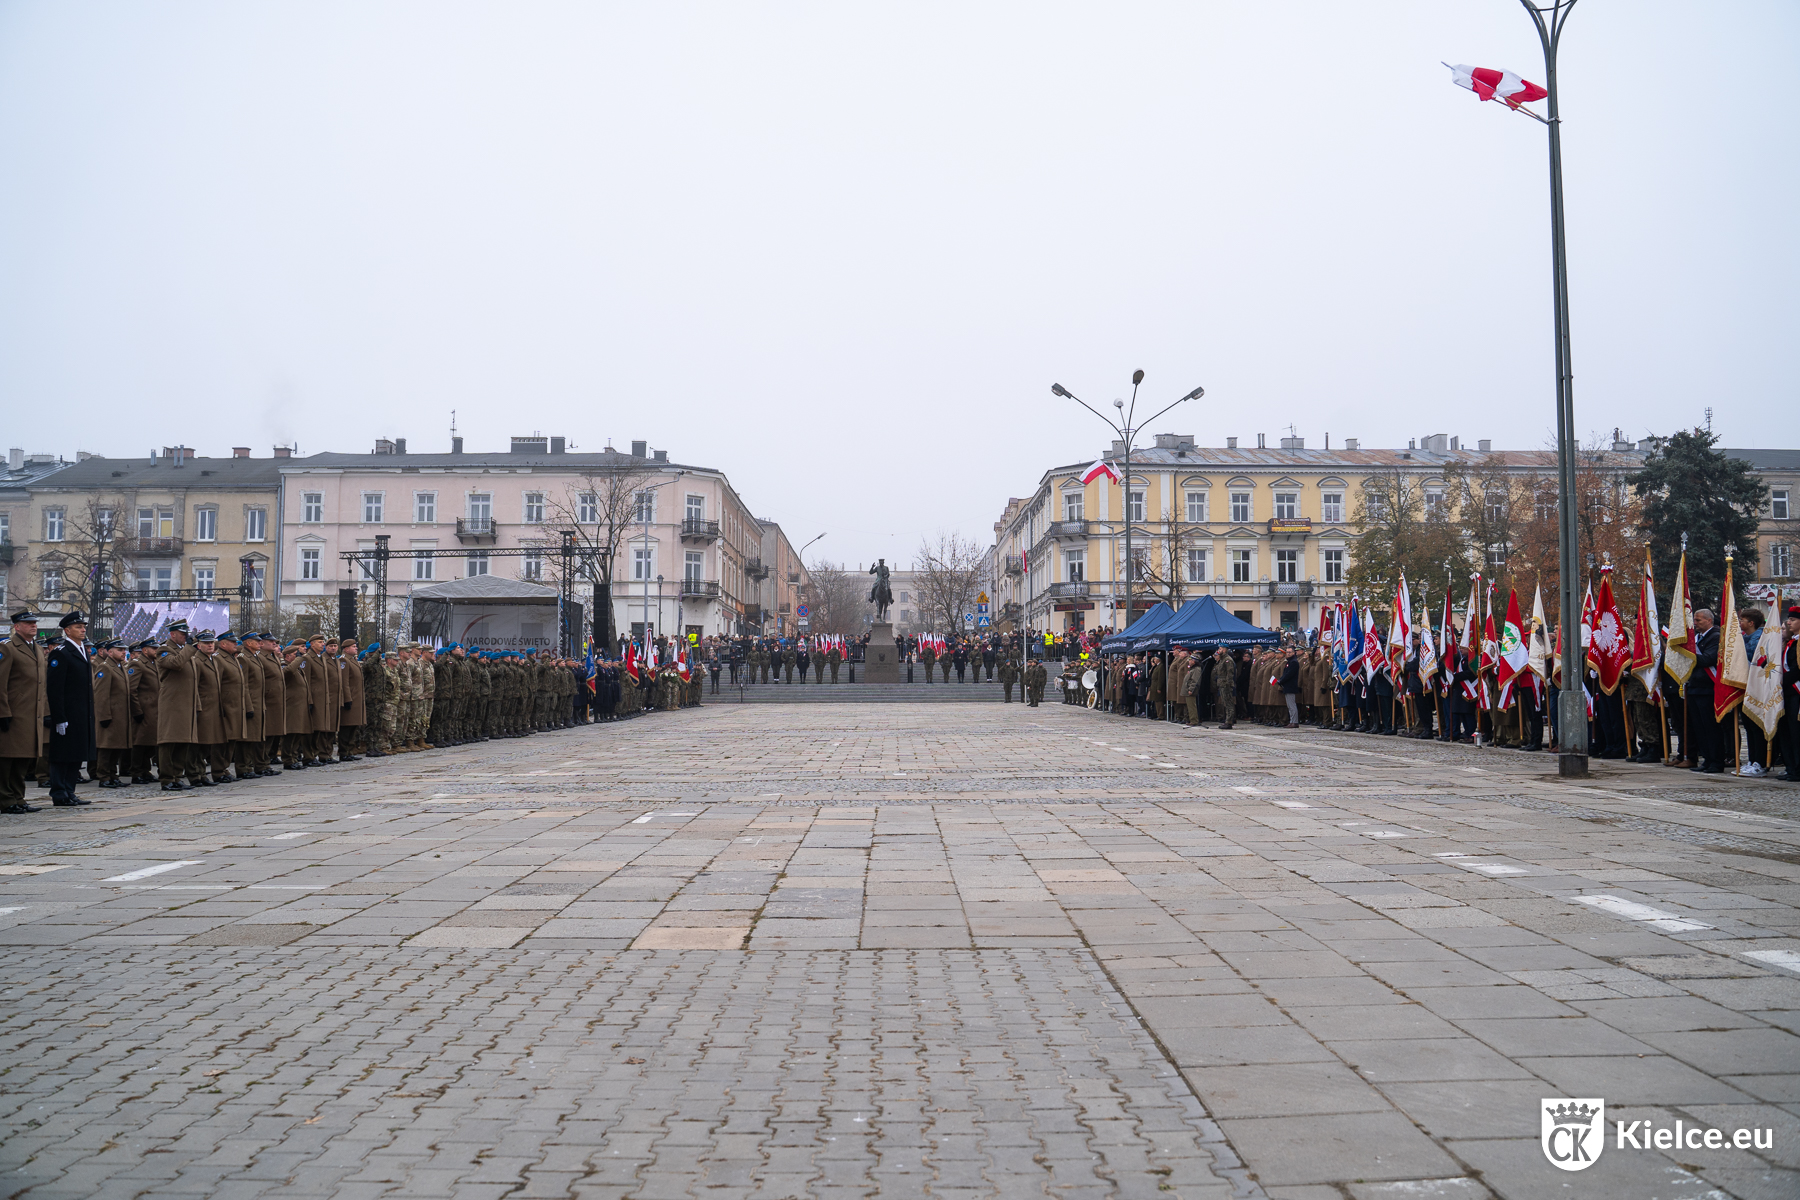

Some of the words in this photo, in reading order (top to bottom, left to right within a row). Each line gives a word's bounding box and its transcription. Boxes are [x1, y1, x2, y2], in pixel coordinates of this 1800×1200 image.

[466, 637, 517, 646] NARODOWE
[518, 635, 551, 647] ŚWIĘTO
[1727, 608, 1739, 649] PODSTAWO
